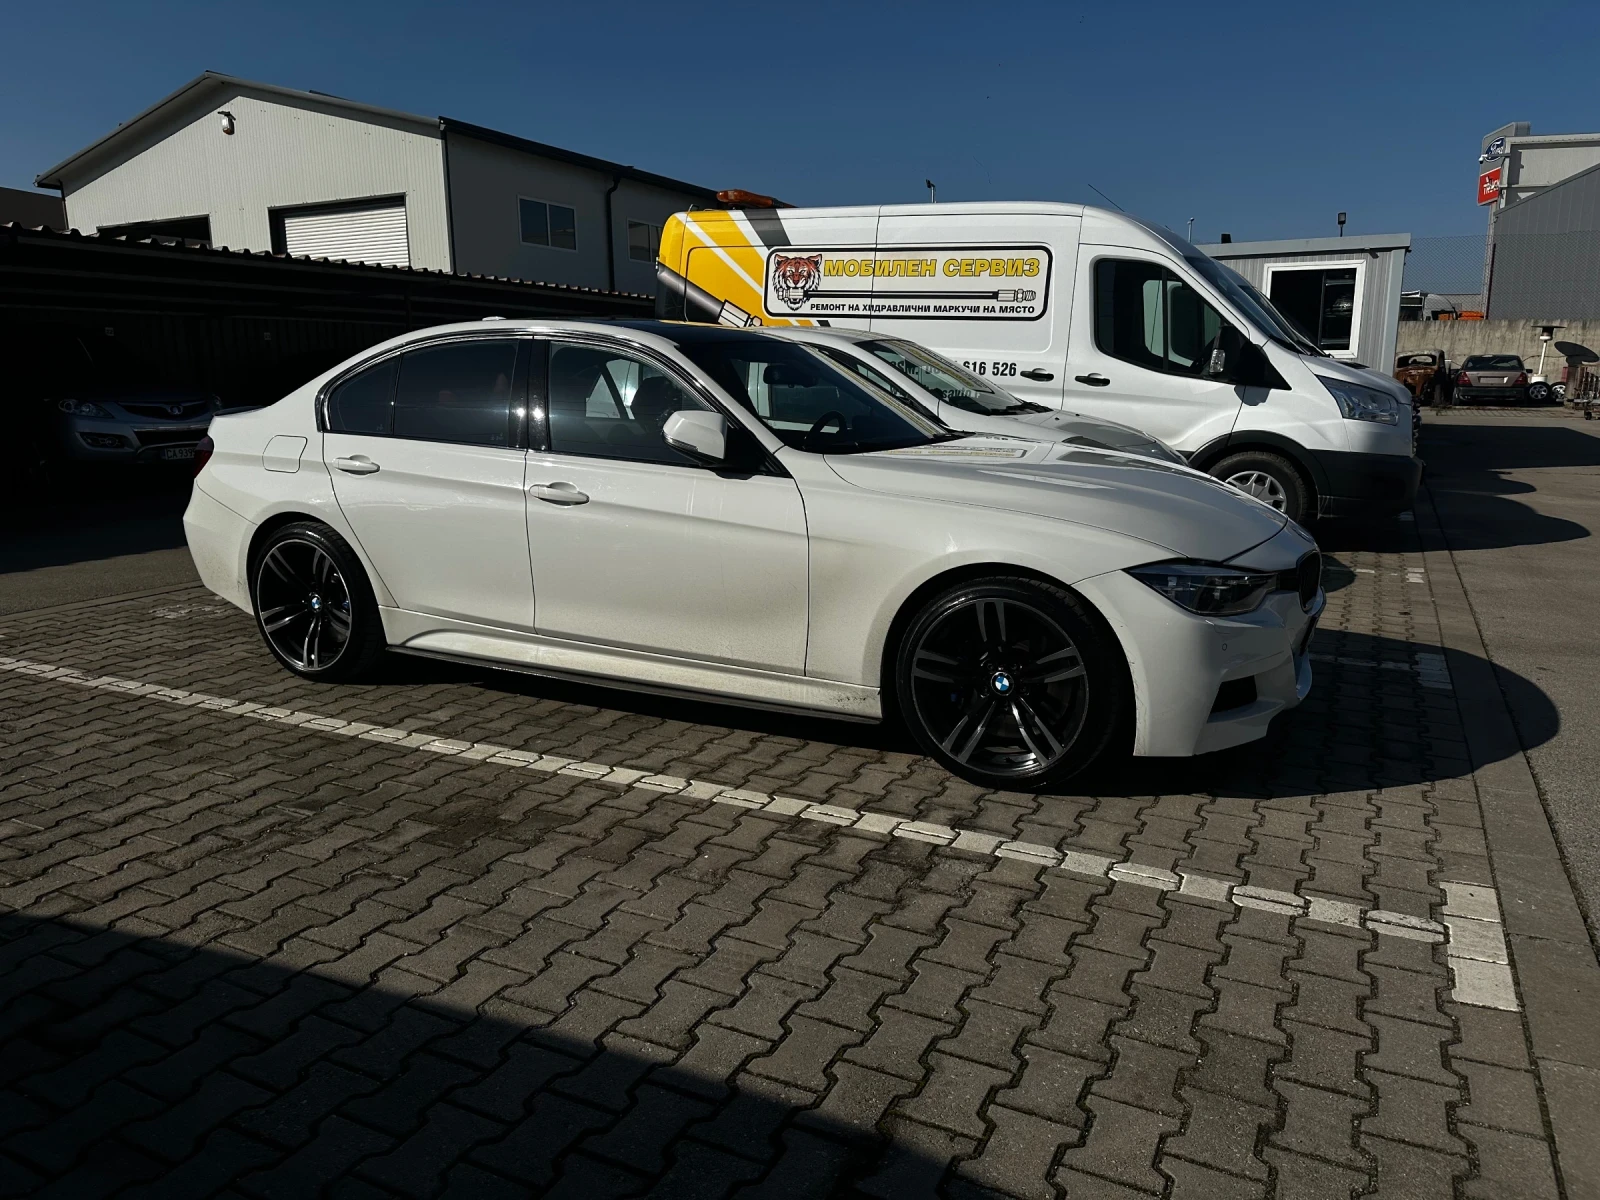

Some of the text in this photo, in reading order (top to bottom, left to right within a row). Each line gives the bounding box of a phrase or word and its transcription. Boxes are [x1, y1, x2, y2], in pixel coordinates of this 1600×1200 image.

[824, 258, 1040, 277] МОБИЛЕН СЕРВИЗ
[810, 303, 846, 311] РЕМОНТ
[862, 304, 930, 312] ХИДРАВЛИЧНИ
[933, 305, 980, 313] МАРКУЧИ
[999, 306, 1035, 314] МЯСТО
[992, 362, 1017, 377] 526
